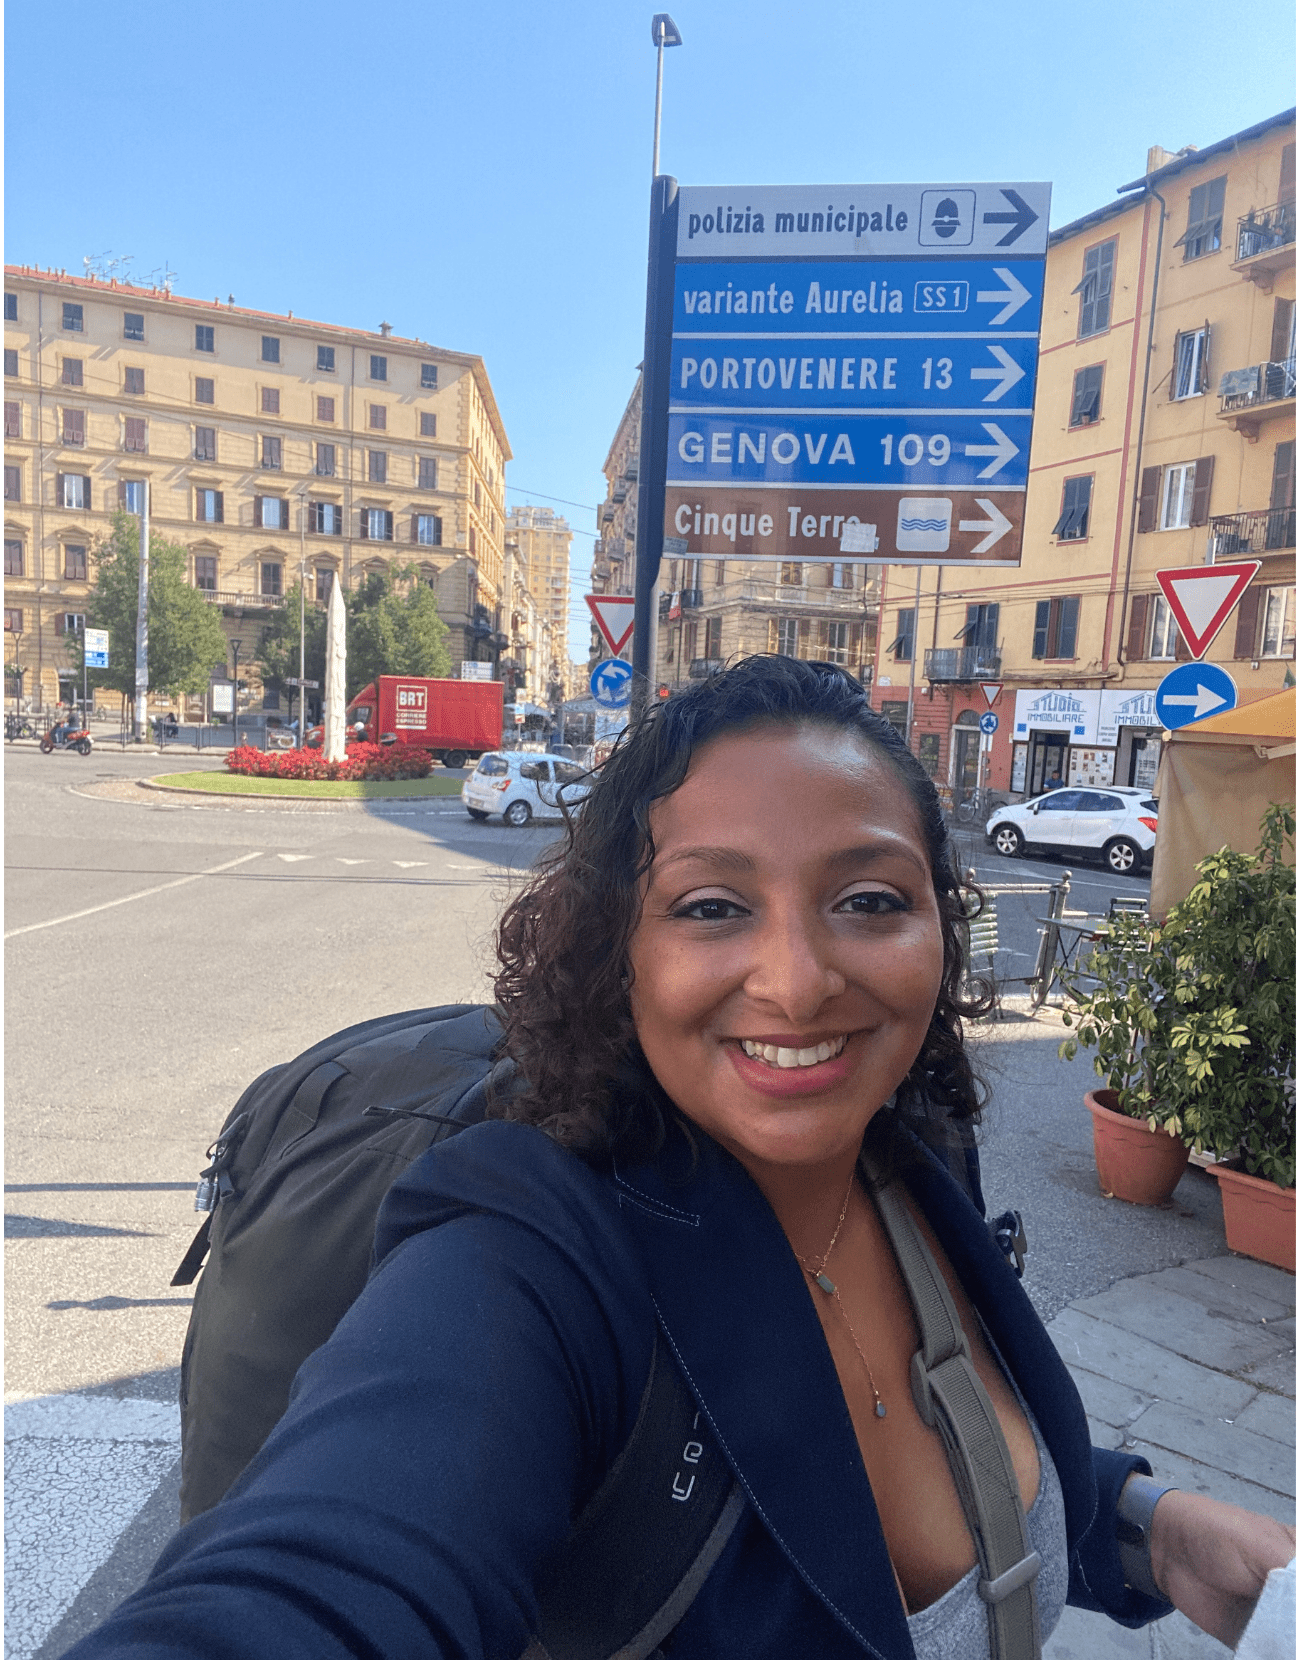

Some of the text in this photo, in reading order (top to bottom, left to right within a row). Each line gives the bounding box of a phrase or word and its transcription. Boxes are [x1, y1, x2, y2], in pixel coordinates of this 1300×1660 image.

[688, 203, 908, 239] polizia municipale
[683, 281, 794, 314] variante
[804, 280, 904, 314] Aurelia
[680, 357, 953, 390] PORTOVENERE 13
[677, 431, 951, 467] GENOVA 109
[674, 503, 774, 541] Cinque
[400, 691, 424, 706] BRT
[1121, 695, 1156, 714] STU
[1027, 713, 1085, 723] IMMOBILIARE
[1115, 715, 1161, 725] IMMOBIL
